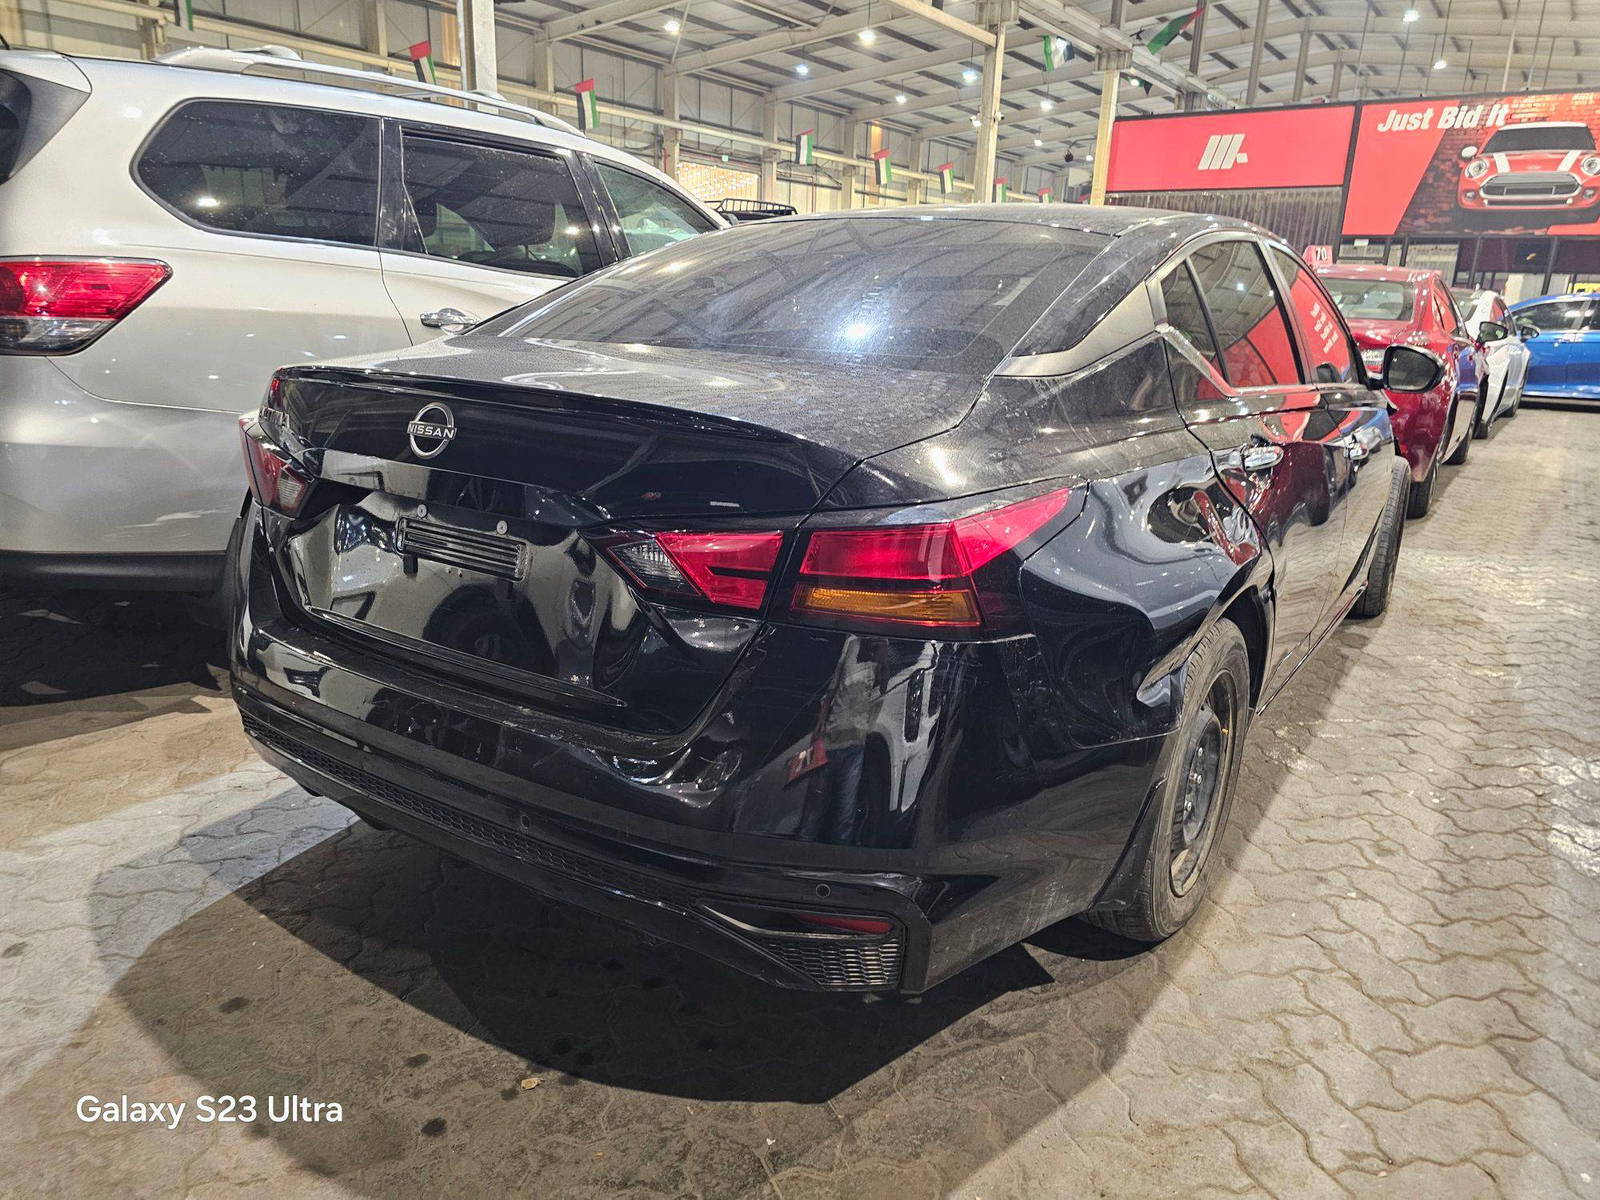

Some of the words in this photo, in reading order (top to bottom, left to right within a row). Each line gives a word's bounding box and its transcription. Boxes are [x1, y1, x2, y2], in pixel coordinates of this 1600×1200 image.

[1377, 108, 1433, 132] Just
[1437, 104, 1484, 129] Bid
[1486, 103, 1509, 128] It
[408, 424, 454, 438] NISSAN
